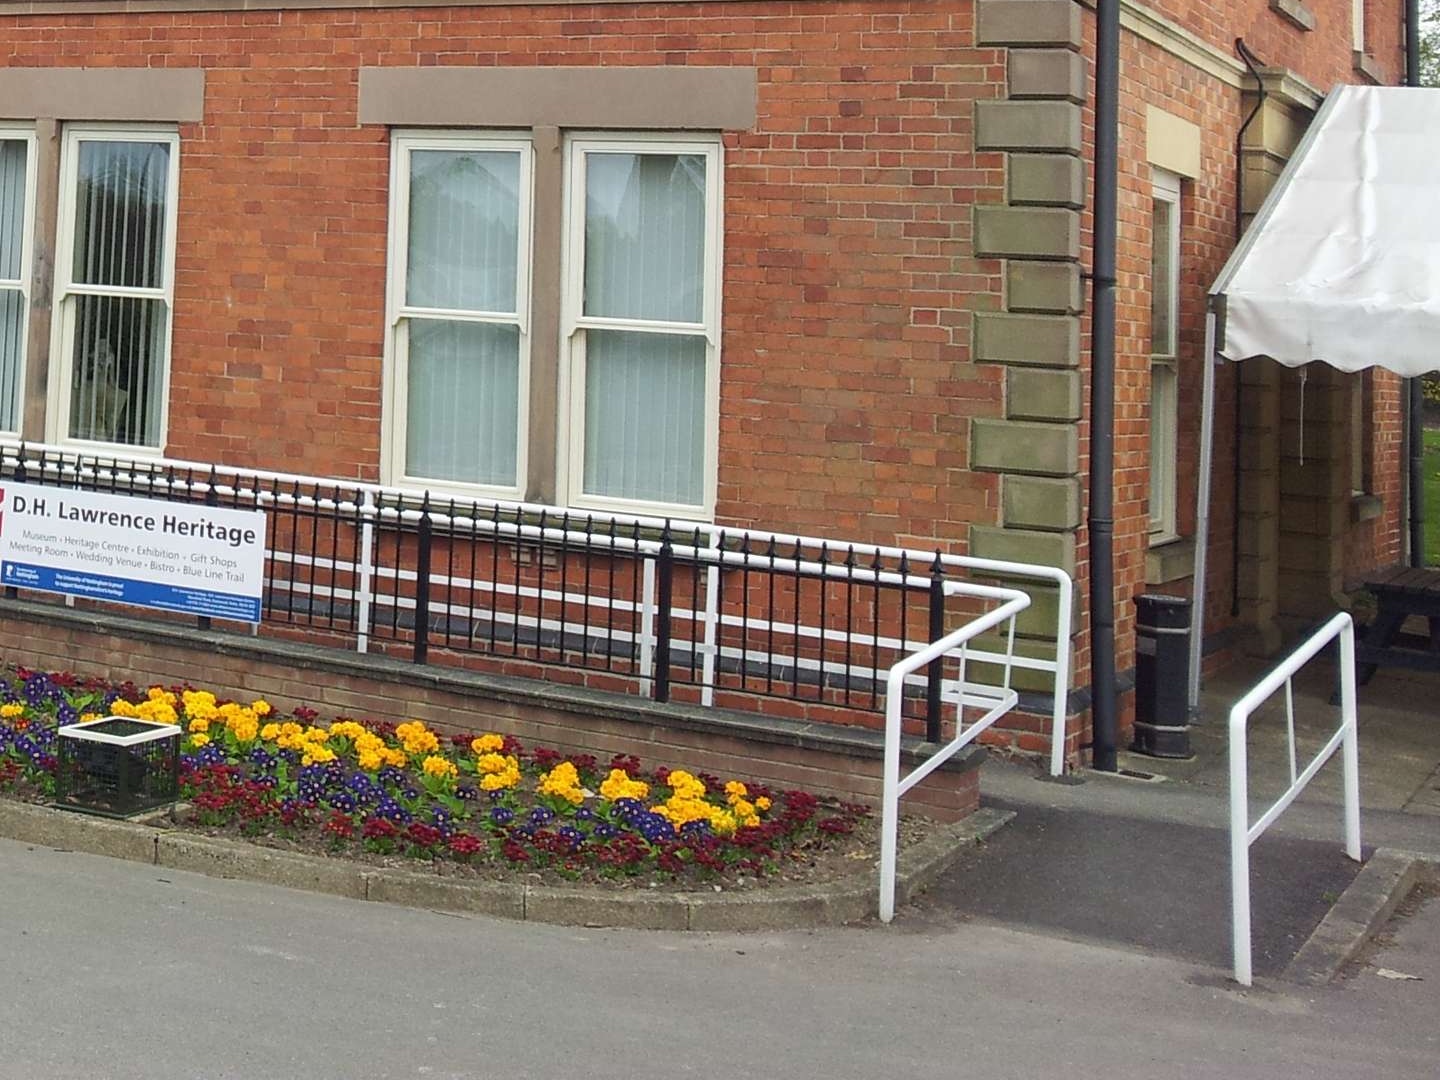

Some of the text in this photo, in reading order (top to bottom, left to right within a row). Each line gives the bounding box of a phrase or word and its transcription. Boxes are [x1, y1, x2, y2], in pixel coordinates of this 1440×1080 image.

[12, 495, 256, 547] D.H. Lawrence Heritage
[9, 541, 43, 556] Meeting
[45, 546, 69, 557] Room
[75, 551, 113, 566] Wedding
[116, 556, 143, 568] Venue
[150, 560, 175, 573] Bistro
[183, 565, 202, 576] Blue
[205, 570, 224, 580] Line
[226, 572, 245, 583] Trail
[22, 529, 238, 568] Museum Heritage Centre Exhibition Gift Shops
